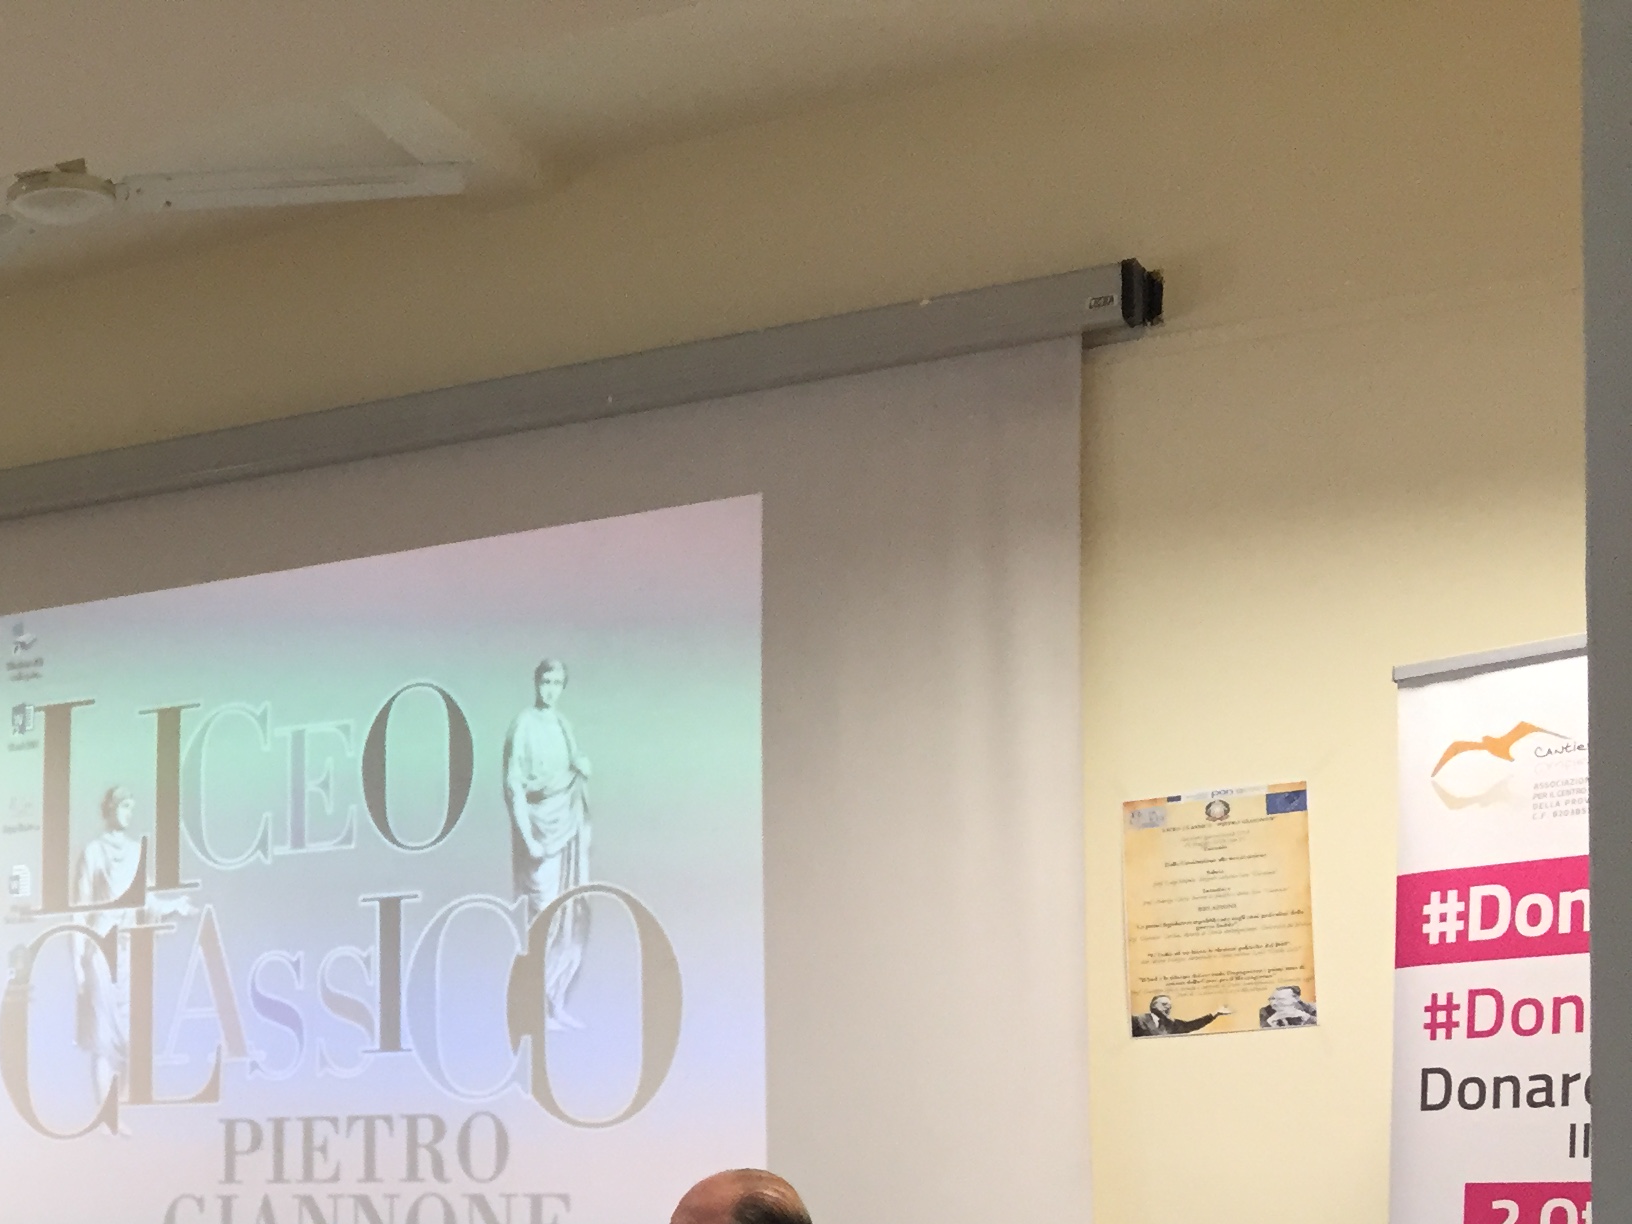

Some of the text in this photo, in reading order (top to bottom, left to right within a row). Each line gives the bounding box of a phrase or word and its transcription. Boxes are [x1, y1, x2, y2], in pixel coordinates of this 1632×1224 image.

[1534, 741, 1589, 758] Cantie
[32, 681, 475, 918] LICEO
[1422, 884, 1590, 945] #Don
[1423, 988, 1584, 1041] #Don
[217, 1109, 511, 1186] PIETRO
